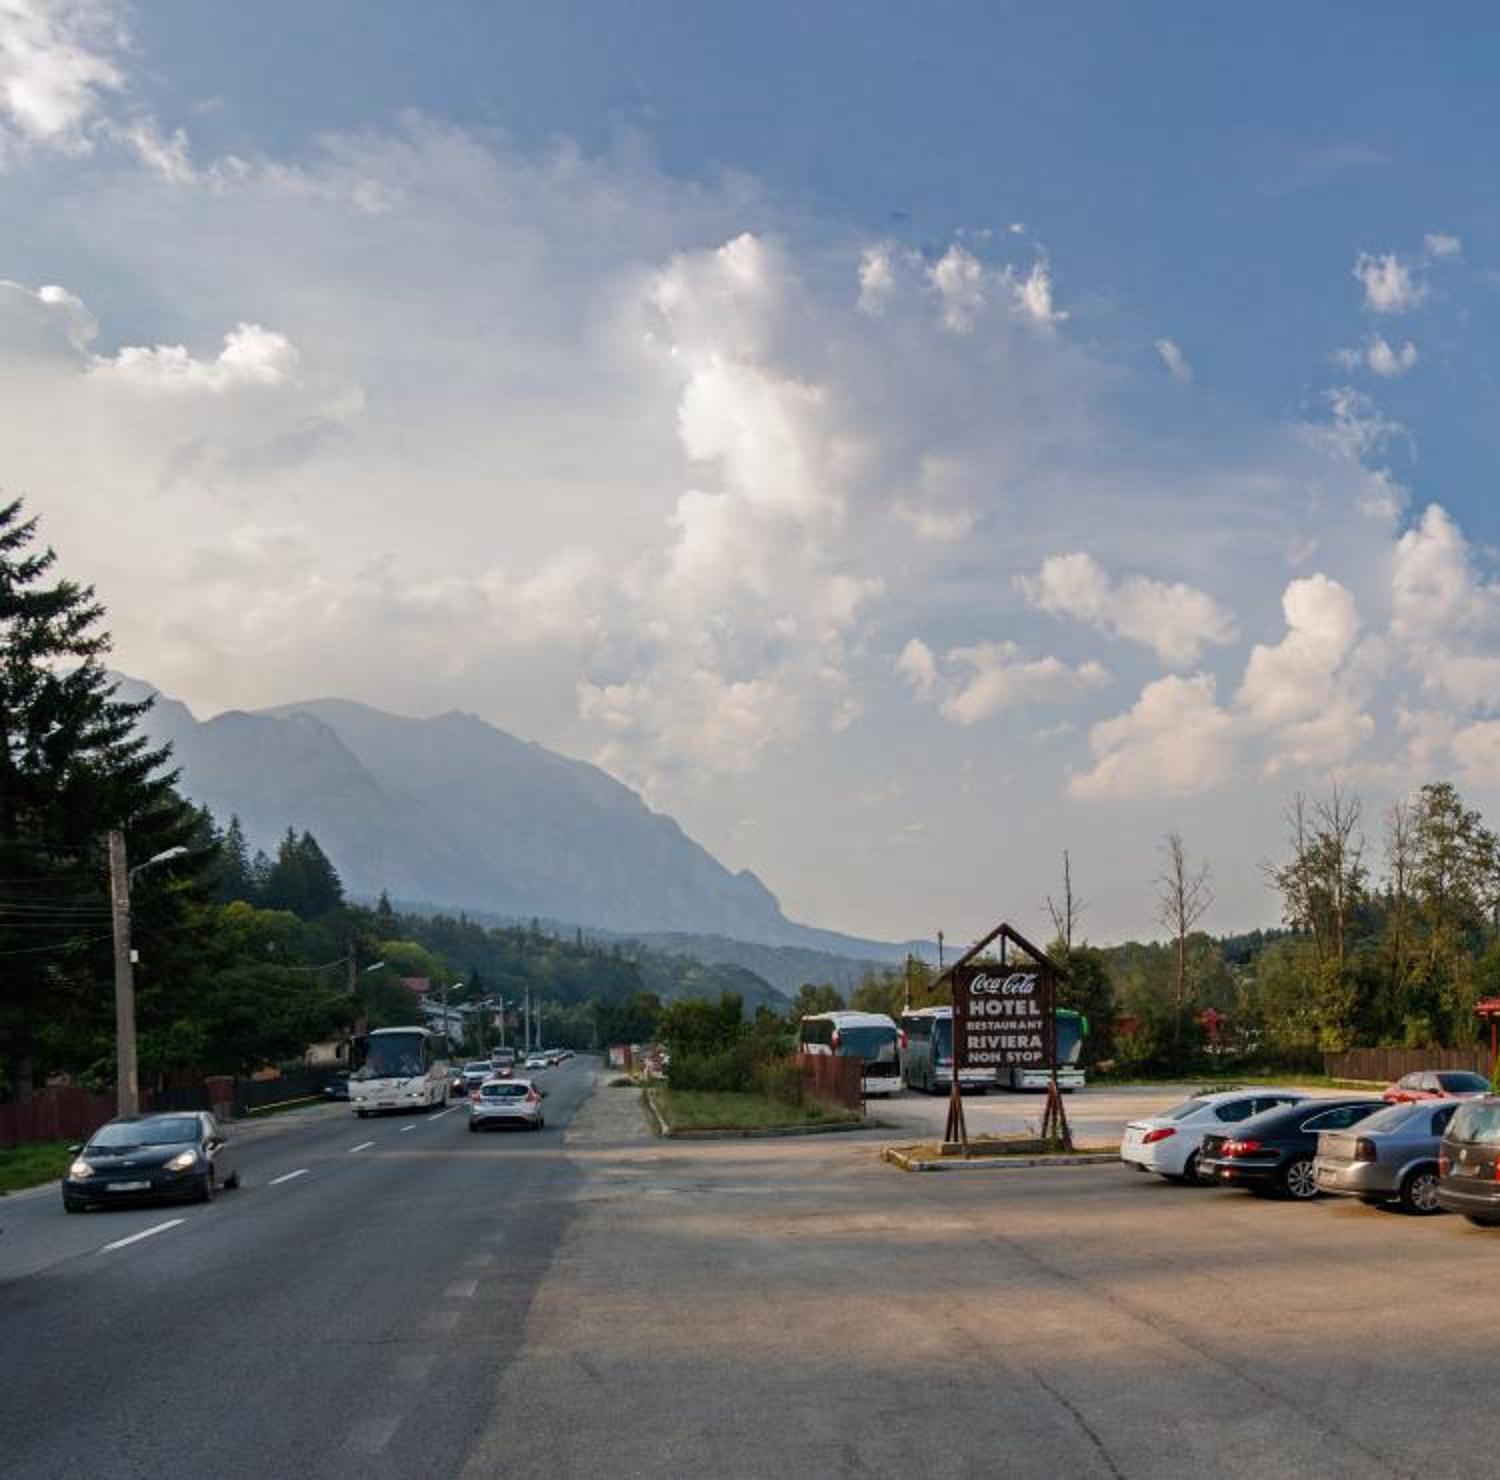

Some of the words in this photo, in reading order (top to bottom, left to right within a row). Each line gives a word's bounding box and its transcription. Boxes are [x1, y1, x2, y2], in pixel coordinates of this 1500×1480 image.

[969, 1000, 1040, 1015] HOTEL
[967, 1021, 1042, 1030] RESTAURANT
[967, 1035, 1042, 1049] RIVIERA
[968, 1052, 1001, 1063] NON
[1006, 1051, 1042, 1062] STOP
